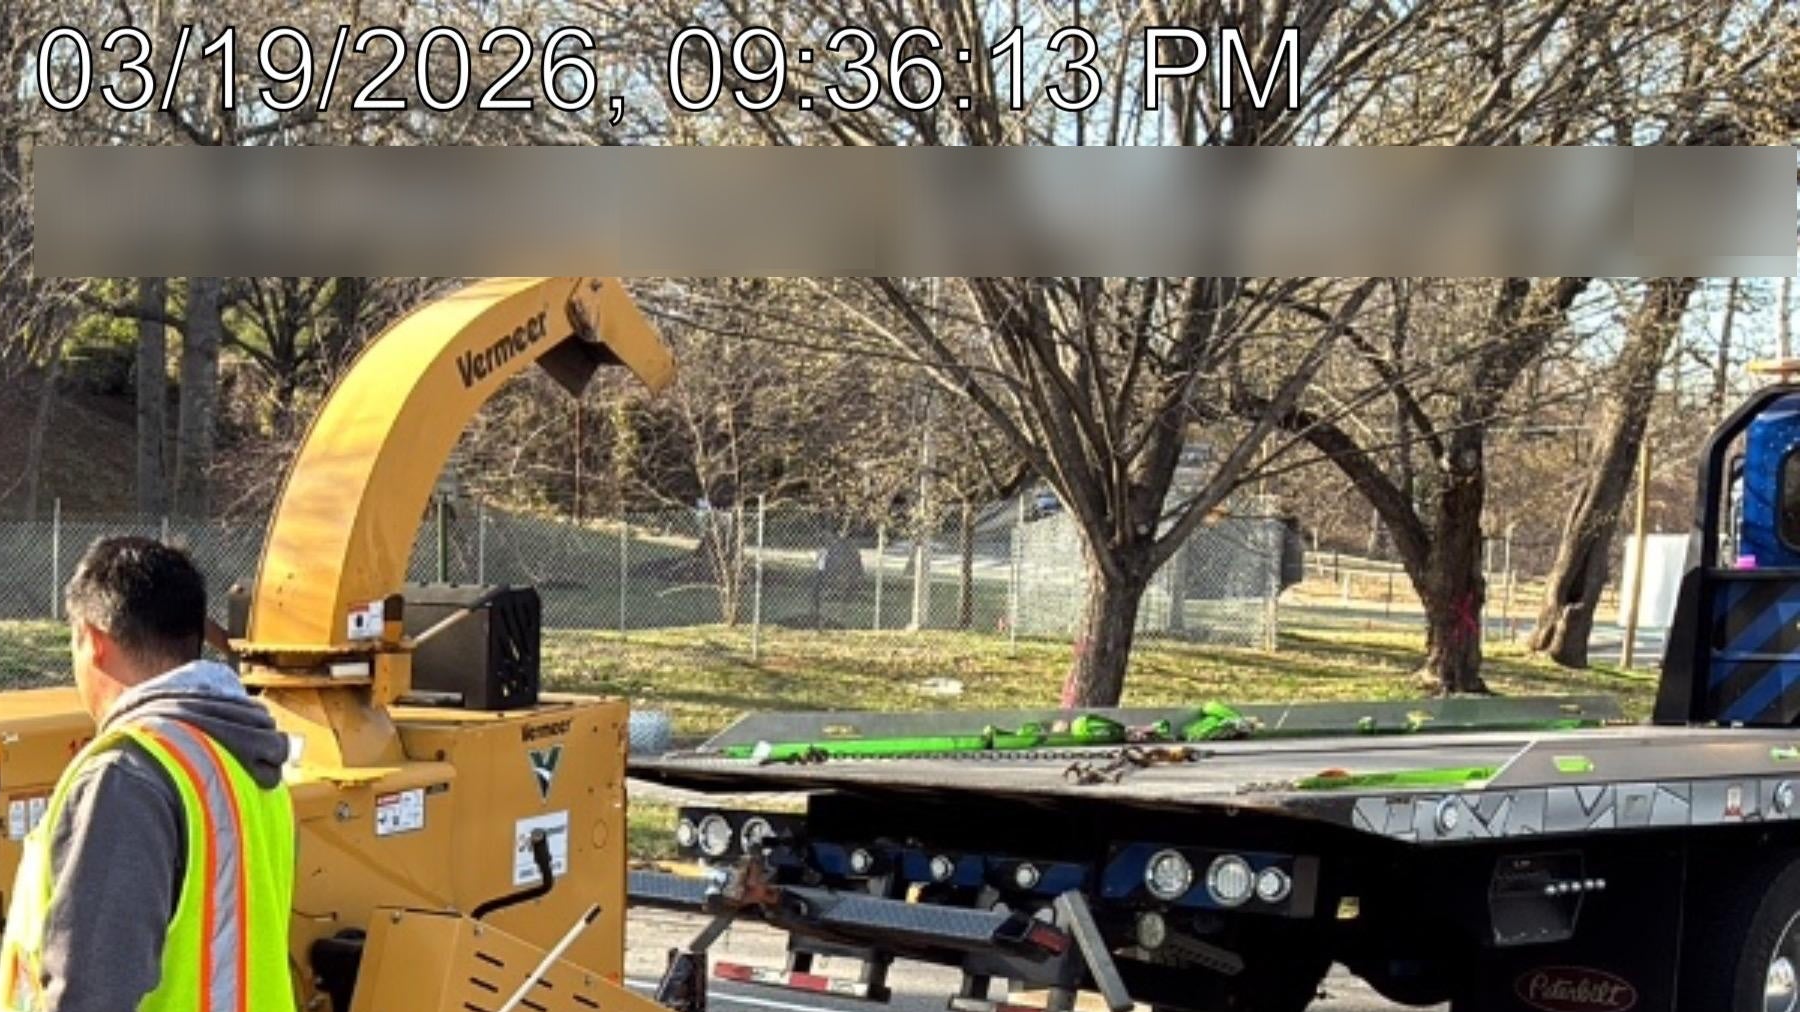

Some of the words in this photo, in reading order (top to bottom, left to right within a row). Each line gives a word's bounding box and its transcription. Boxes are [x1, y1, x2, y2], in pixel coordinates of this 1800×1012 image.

[457, 310, 547, 389] Vermeer
[521, 719, 571, 742] Vermeer
[1528, 973, 1627, 1006] Peterbilt
